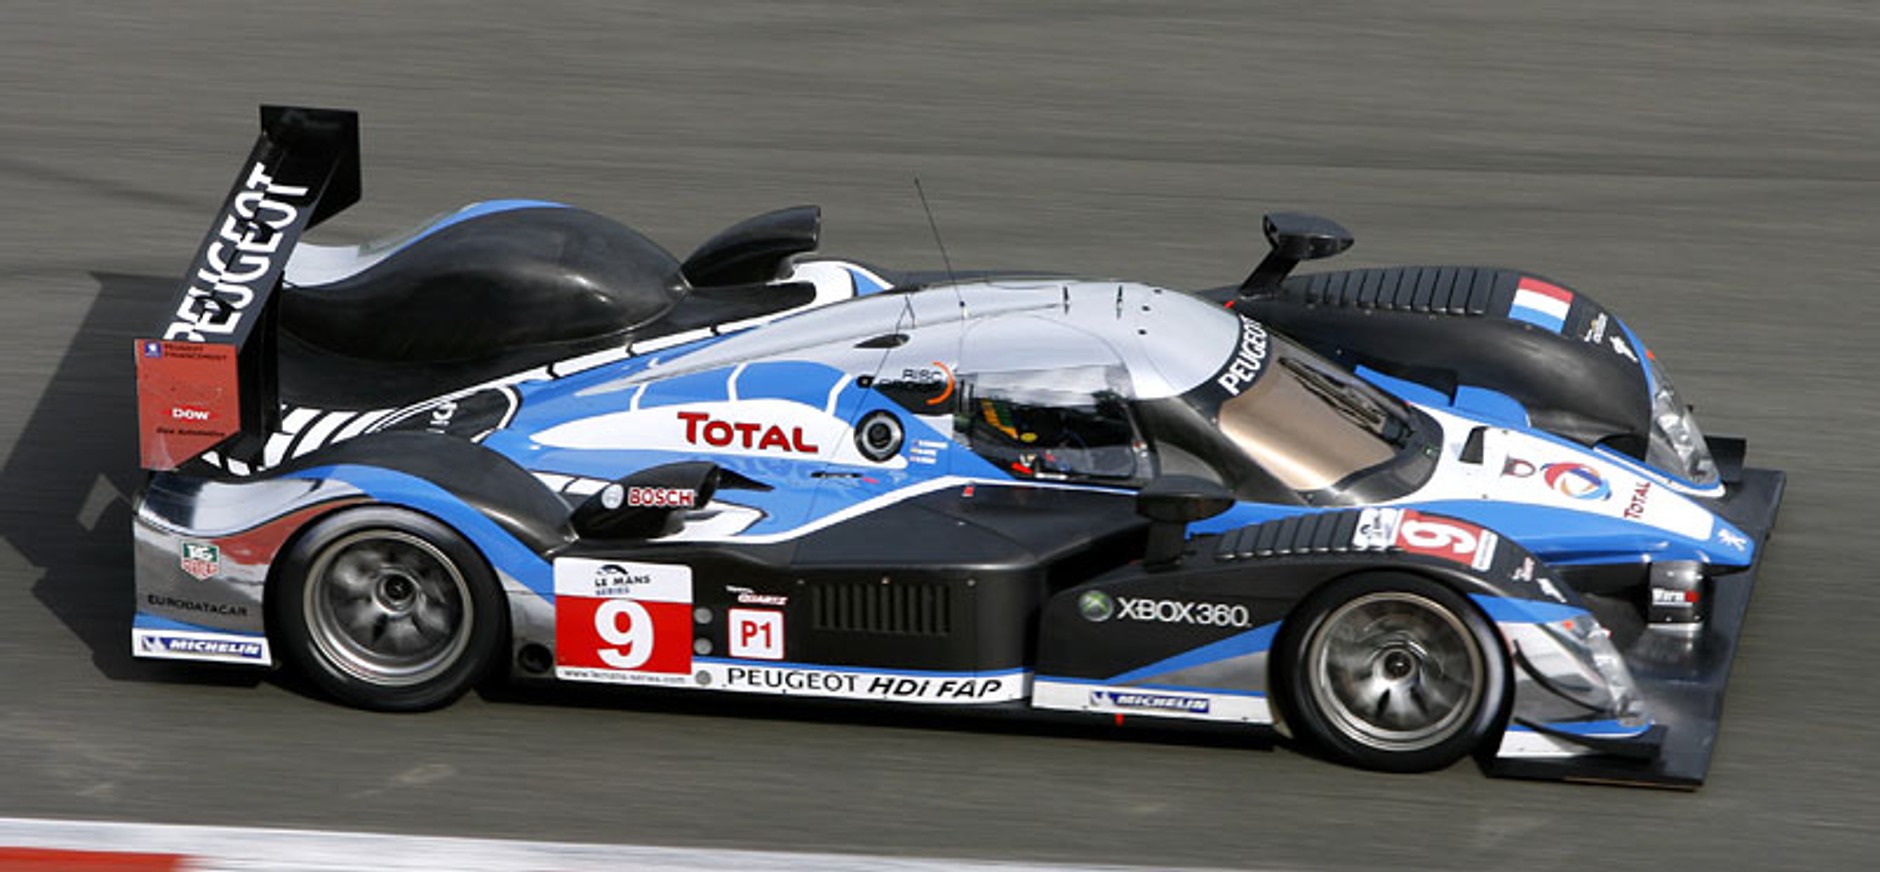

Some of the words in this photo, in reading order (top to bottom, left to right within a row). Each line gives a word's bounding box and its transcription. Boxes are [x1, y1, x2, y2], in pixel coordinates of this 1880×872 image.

[677, 411, 819, 453] TOTAL
[628, 486, 696, 507] BOSCH
[1624, 481, 1651, 519] TOTAL
[1401, 520, 1477, 554] 9
[595, 578, 607, 586] LE
[613, 575, 651, 586] MANS
[147, 594, 249, 617] EURODATACAR
[169, 638, 260, 655] MICHELIN
[594, 599, 655, 669] 9
[741, 620, 772, 649] P1
[727, 668, 859, 692] PEUGEOT
[935, 679, 1002, 698] FAP
[1116, 693, 1209, 712] MICHELIN
